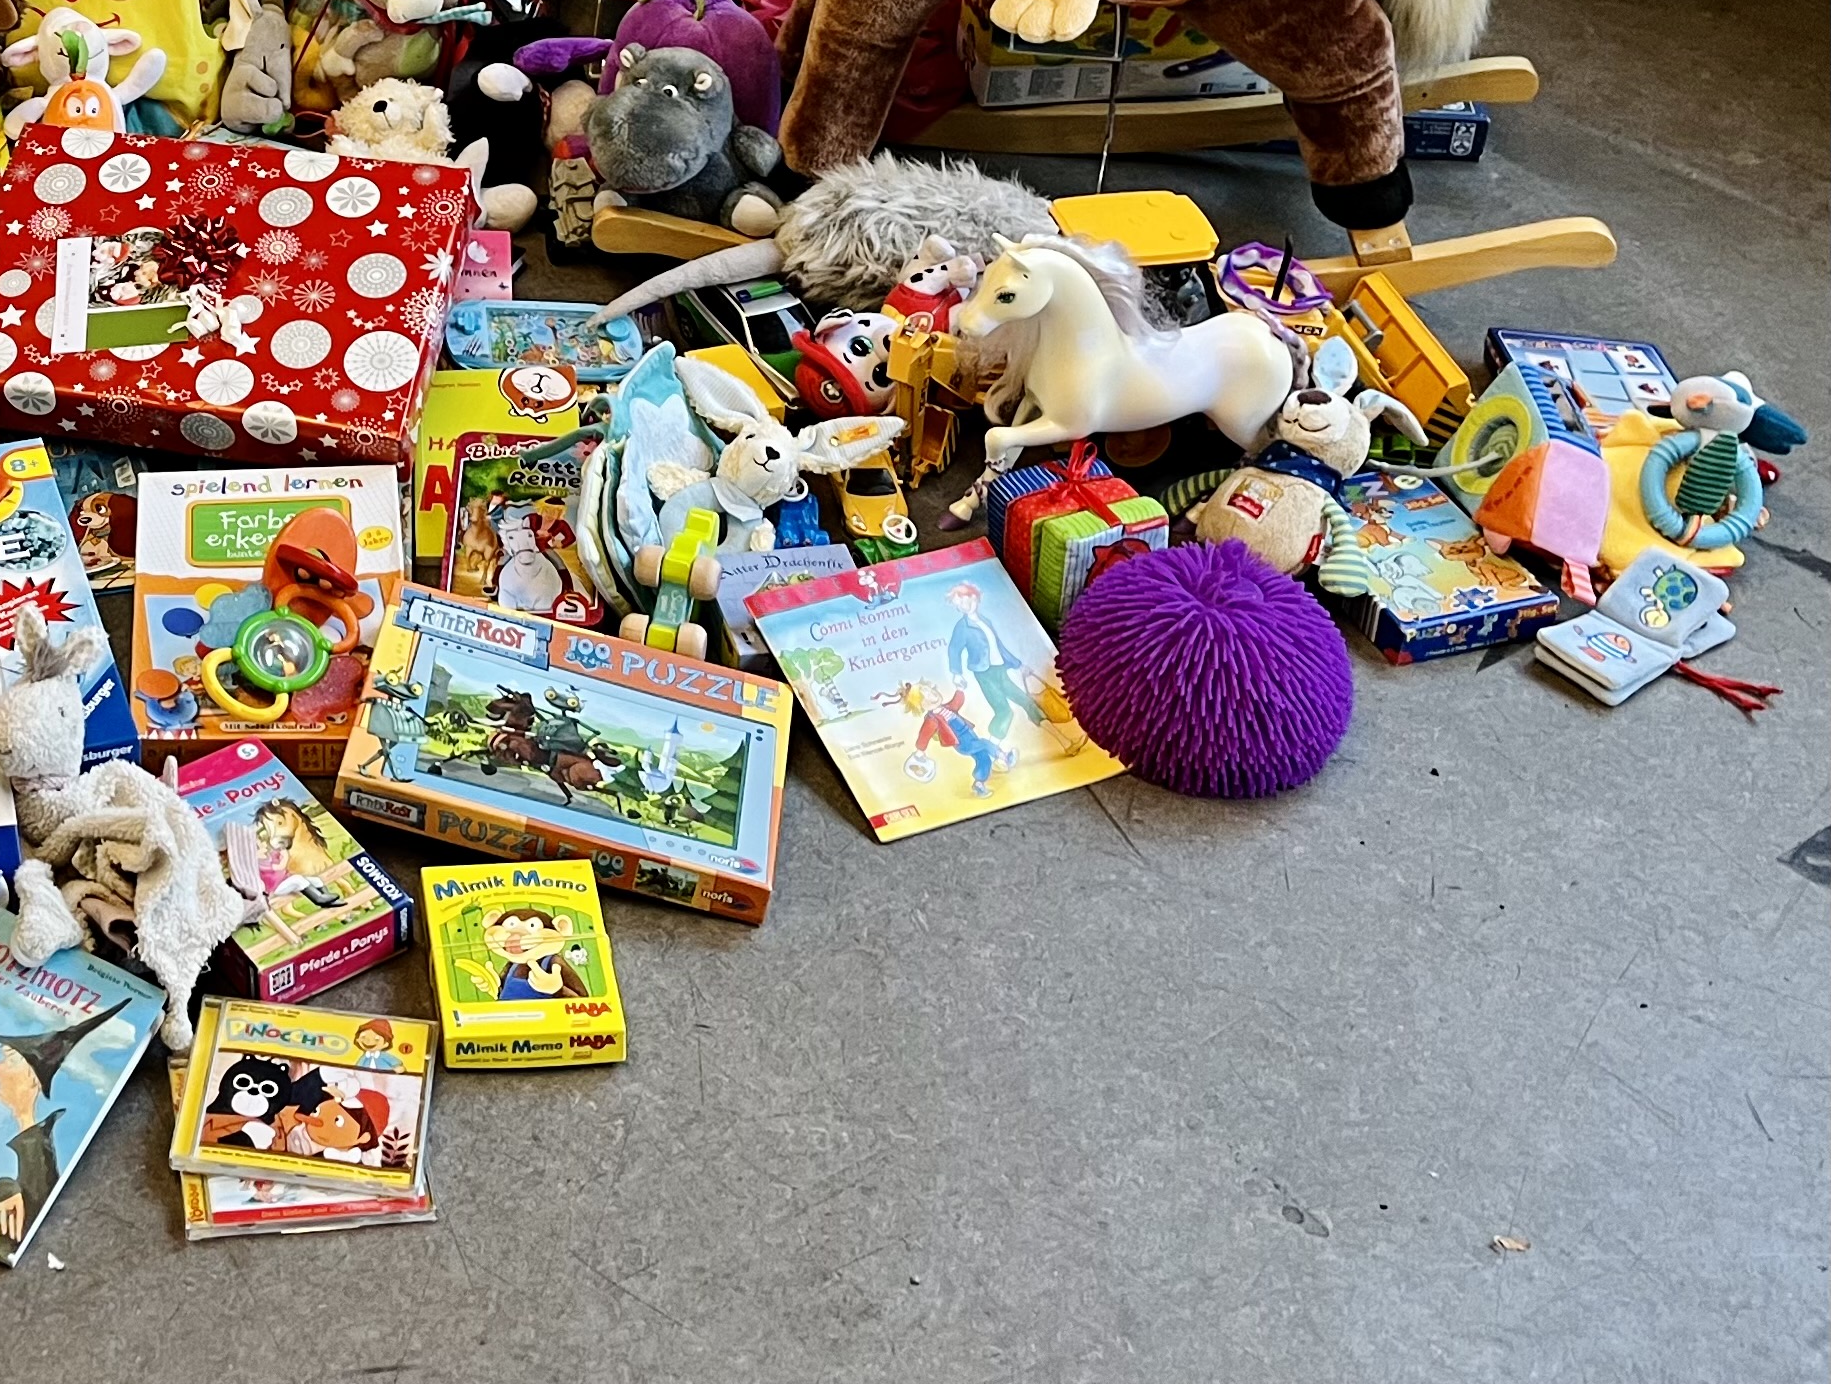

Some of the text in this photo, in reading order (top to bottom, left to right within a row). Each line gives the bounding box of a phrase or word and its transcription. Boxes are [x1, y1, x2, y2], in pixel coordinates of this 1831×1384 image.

[466, 443, 509, 462] Bibi
[170, 473, 364, 499] spielend lernen
[508, 470, 582, 489] Renne
[808, 602, 912, 643] Conni kommt
[861, 625, 910, 648] in den
[847, 636, 948, 673] Kindergarten
[566, 634, 782, 715] 100 PUZZLE
[82, 677, 116, 721] sburger
[82, 744, 134, 762] sburger
[224, 771, 287, 805] Ponys
[708, 852, 742, 870] noris
[355, 855, 404, 902] KOSMOS
[432, 869, 588, 901] Mimik Memo
[701, 888, 736, 907] noris
[299, 949, 342, 977] Pferde
[350, 924, 389, 953] Ponys
[14, 983, 72, 1017] Zauberer
[564, 1002, 613, 1018] HABA
[227, 1018, 349, 1056] PINOCCHIO
[455, 1034, 617, 1057] Mimik Memo HABA
